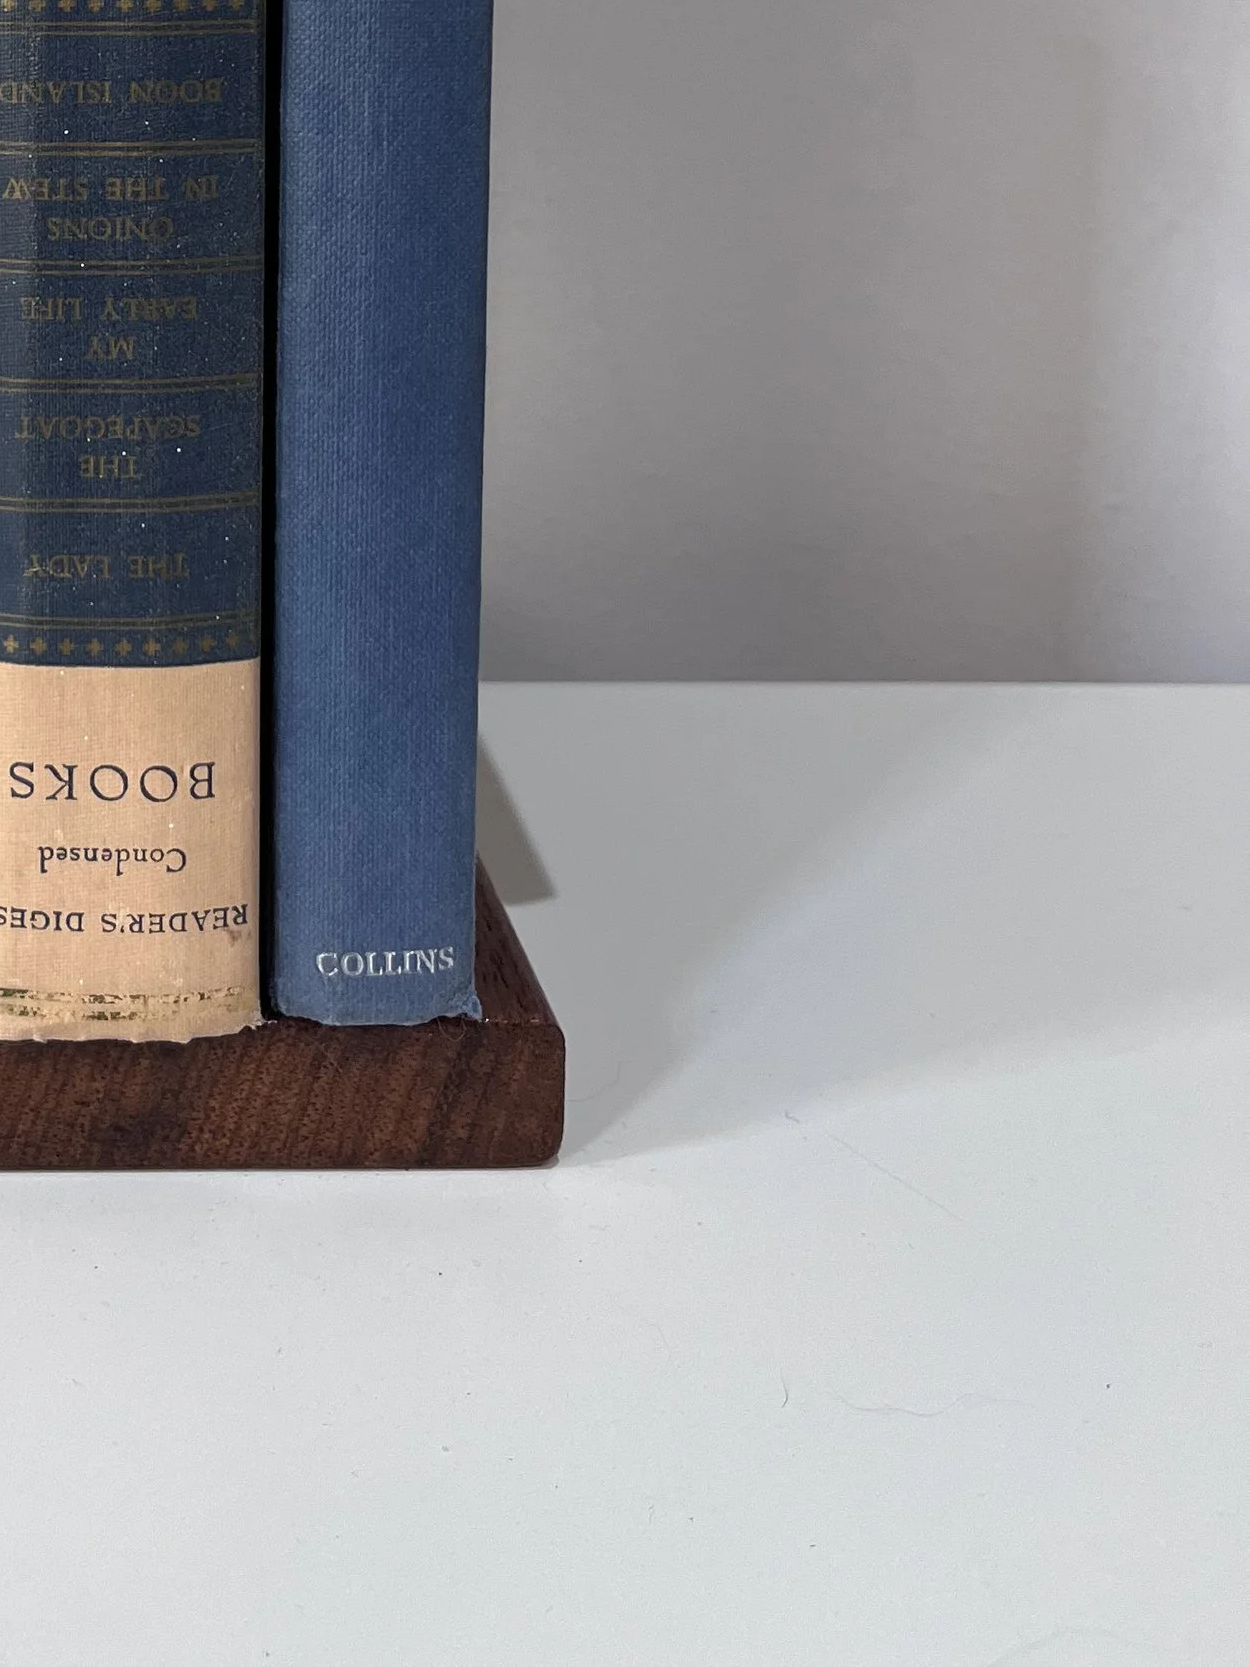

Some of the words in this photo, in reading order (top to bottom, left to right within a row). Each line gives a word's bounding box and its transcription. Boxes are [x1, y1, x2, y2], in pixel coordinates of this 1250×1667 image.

[129, 81, 224, 104] BOON
[2, 177, 88, 201] STEW
[105, 177, 169, 201] THE
[184, 175, 219, 200] IN
[46, 216, 175, 242] ONIONS
[20, 296, 83, 322] LIFE
[101, 296, 199, 322] EARLY
[84, 335, 135, 361] MY
[14, 414, 201, 440] SCAPEGOAT
[79, 454, 141, 479] THE
[23, 553, 111, 578] LADY
[129, 553, 190, 579] THE
[8, 761, 215, 803] BOOKS
[38, 846, 187, 877] Condensed
[100, 903, 249, 934] READER'S
[316, 946, 454, 976] COLLINS
